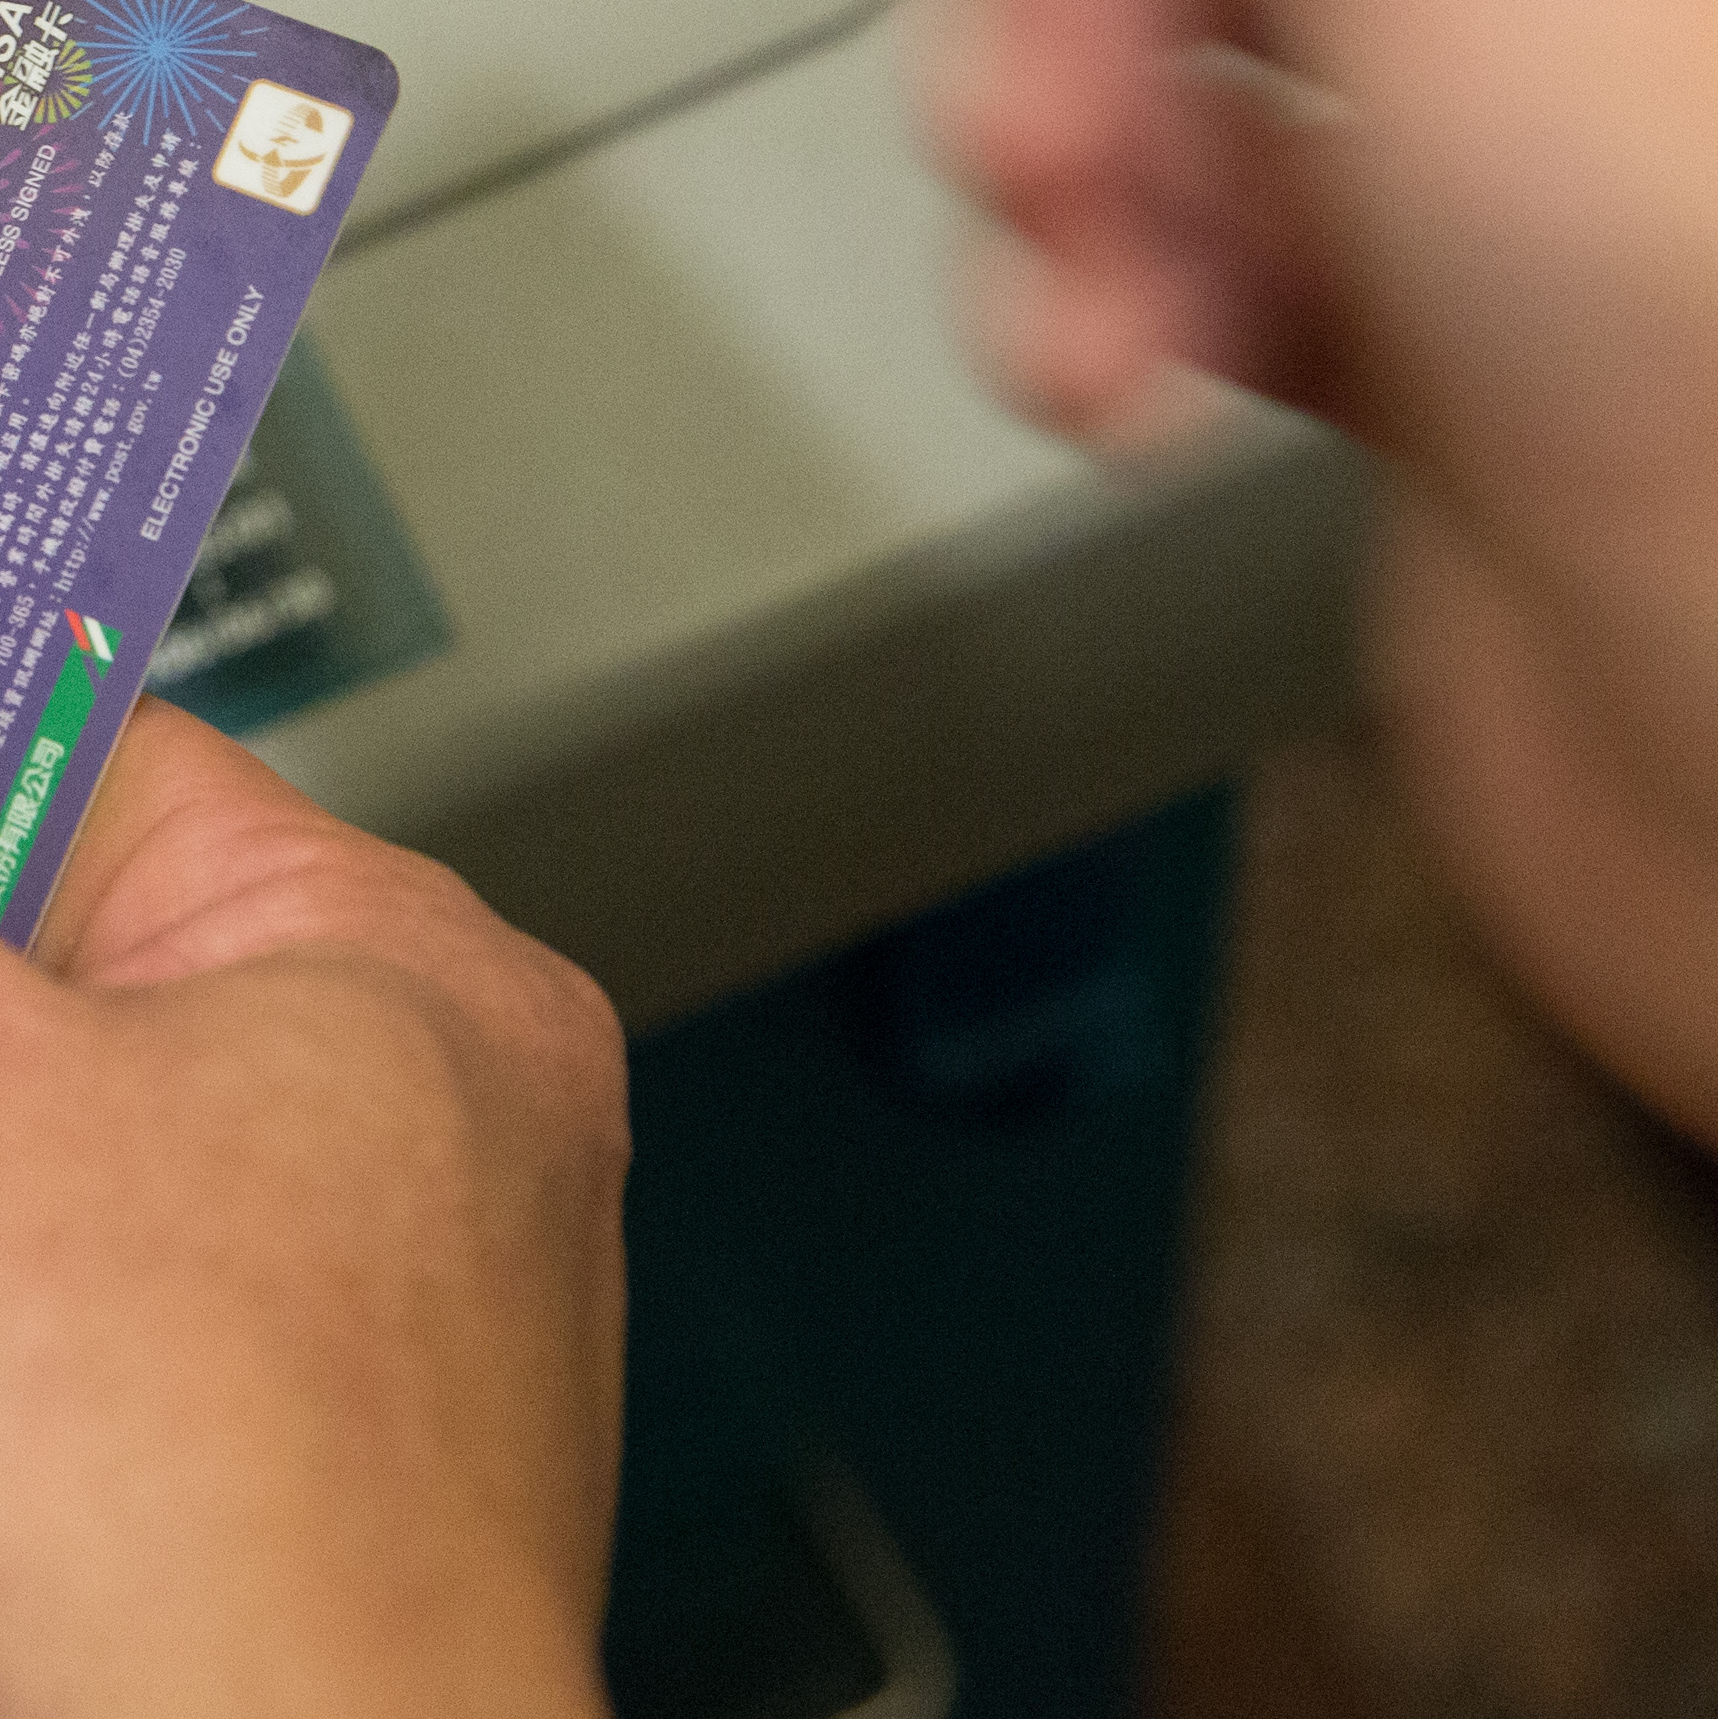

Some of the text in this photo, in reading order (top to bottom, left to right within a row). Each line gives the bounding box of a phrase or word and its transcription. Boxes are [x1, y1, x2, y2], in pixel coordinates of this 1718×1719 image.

[8, 141, 59, 223] SIGNED
[139, 283, 267, 542] ELECTRONIC USE ONLY
